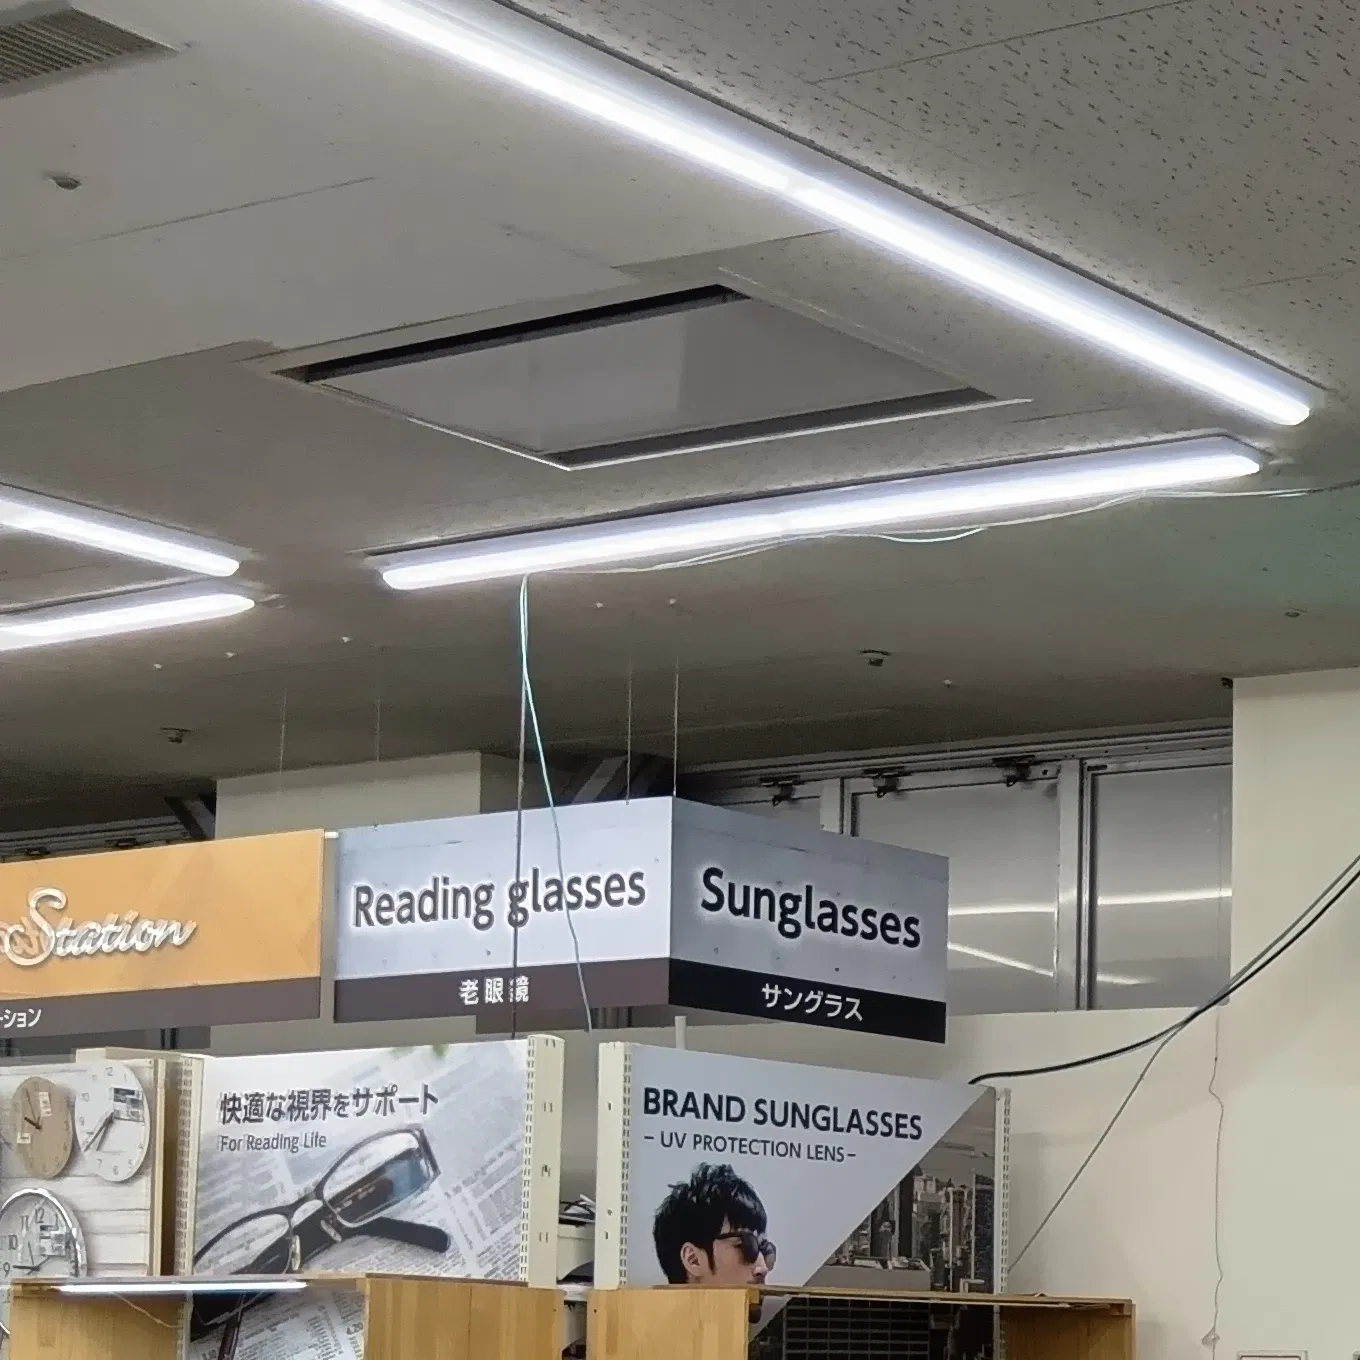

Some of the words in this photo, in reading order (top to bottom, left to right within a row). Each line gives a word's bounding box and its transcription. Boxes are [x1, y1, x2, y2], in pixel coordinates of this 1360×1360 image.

[352, 877, 495, 931] Reading
[507, 866, 646, 928] glasses
[700, 866, 922, 950] Sunglasses
[4, 886, 198, 967] Station
[458, 976, 529, 1006] 老眼鏡
[762, 983, 864, 1023] サングラス
[0, 1008, 42, 1029] ション
[219, 1083, 440, 1126] 快適な視界をサポート
[643, 1086, 746, 1124] BRAND
[752, 1098, 924, 1141] SUNGLASSES
[220, 1135, 243, 1152] For
[246, 1134, 299, 1154] Reading
[303, 1133, 327, 1150] Life
[660, 1131, 688, 1149] UV
[692, 1134, 802, 1159] PROTECTION
[806, 1144, 845, 1163] LENS
